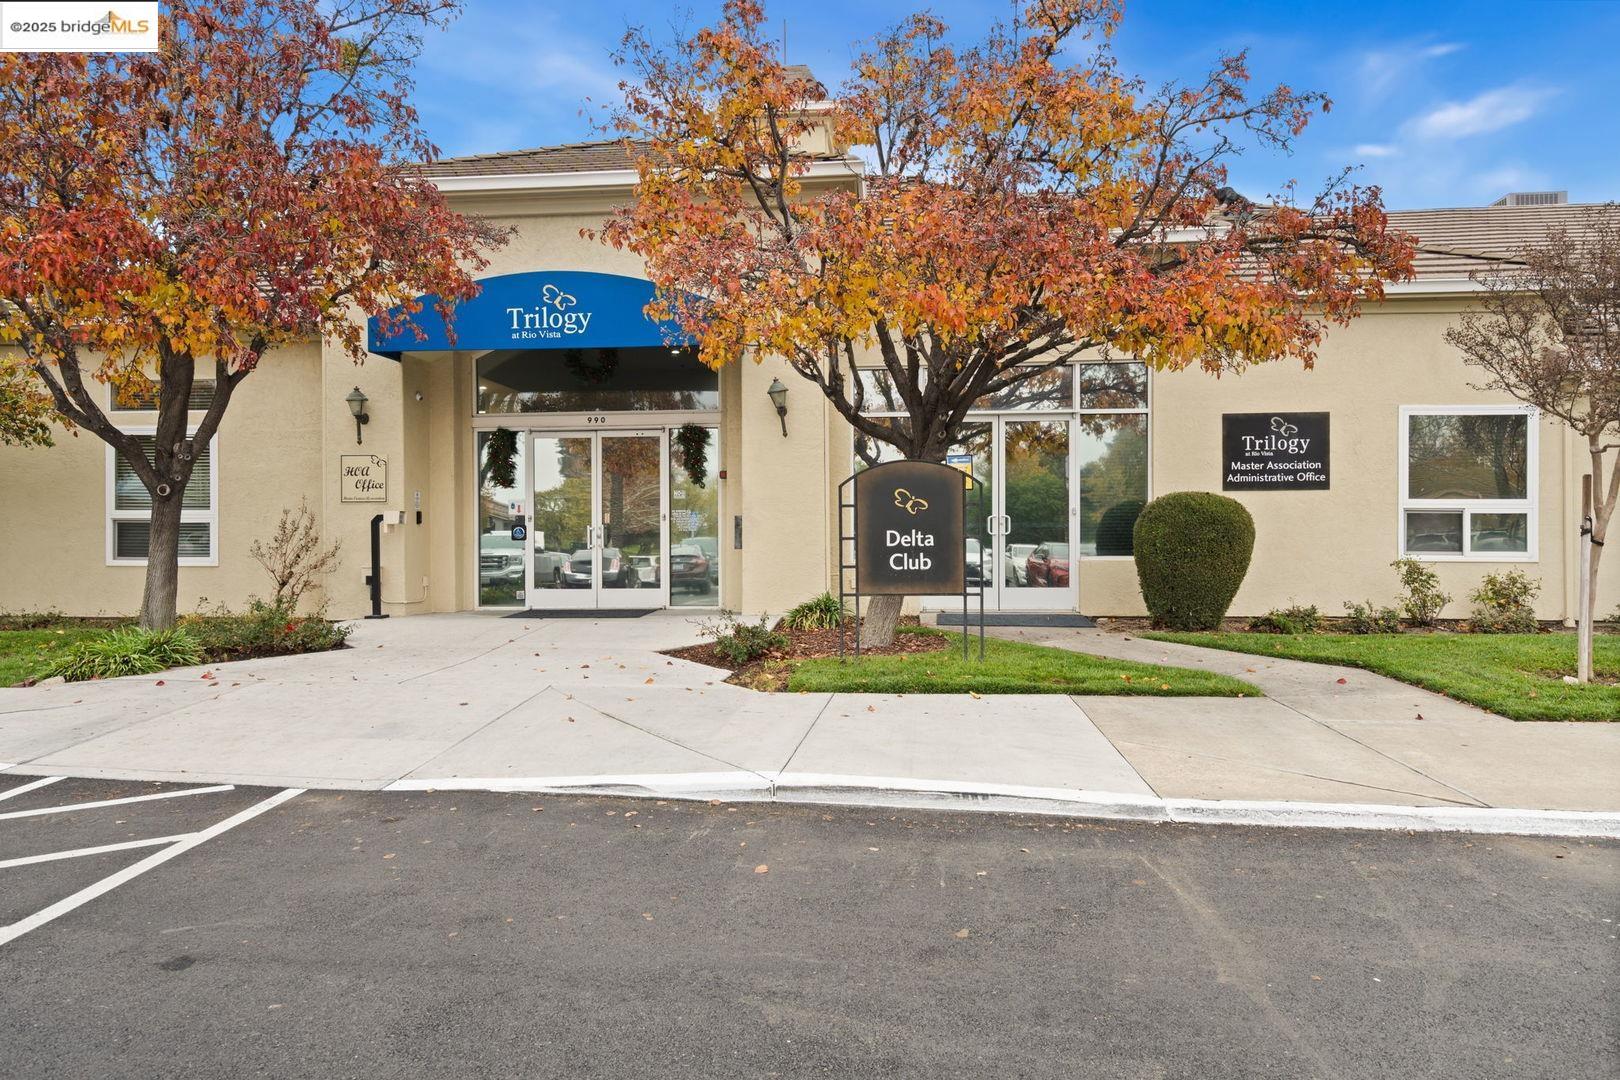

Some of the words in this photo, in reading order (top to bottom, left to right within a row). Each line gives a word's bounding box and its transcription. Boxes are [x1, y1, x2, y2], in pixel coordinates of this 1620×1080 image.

[506, 306, 593, 335] Trilogy
[521, 330, 537, 339] Rio
[539, 330, 561, 339] Vista
[587, 416, 606, 424] 990
[1241, 434, 1311, 454] Trilogy
[343, 466, 371, 477] HOA
[1231, 461, 1265, 471] Master
[1266, 460, 1322, 470] Association
[1226, 473, 1295, 483] Administrative
[1297, 472, 1326, 482] Office
[355, 479, 385, 492] Office
[886, 529, 935, 547] Delta
[889, 552, 932, 571] Club
